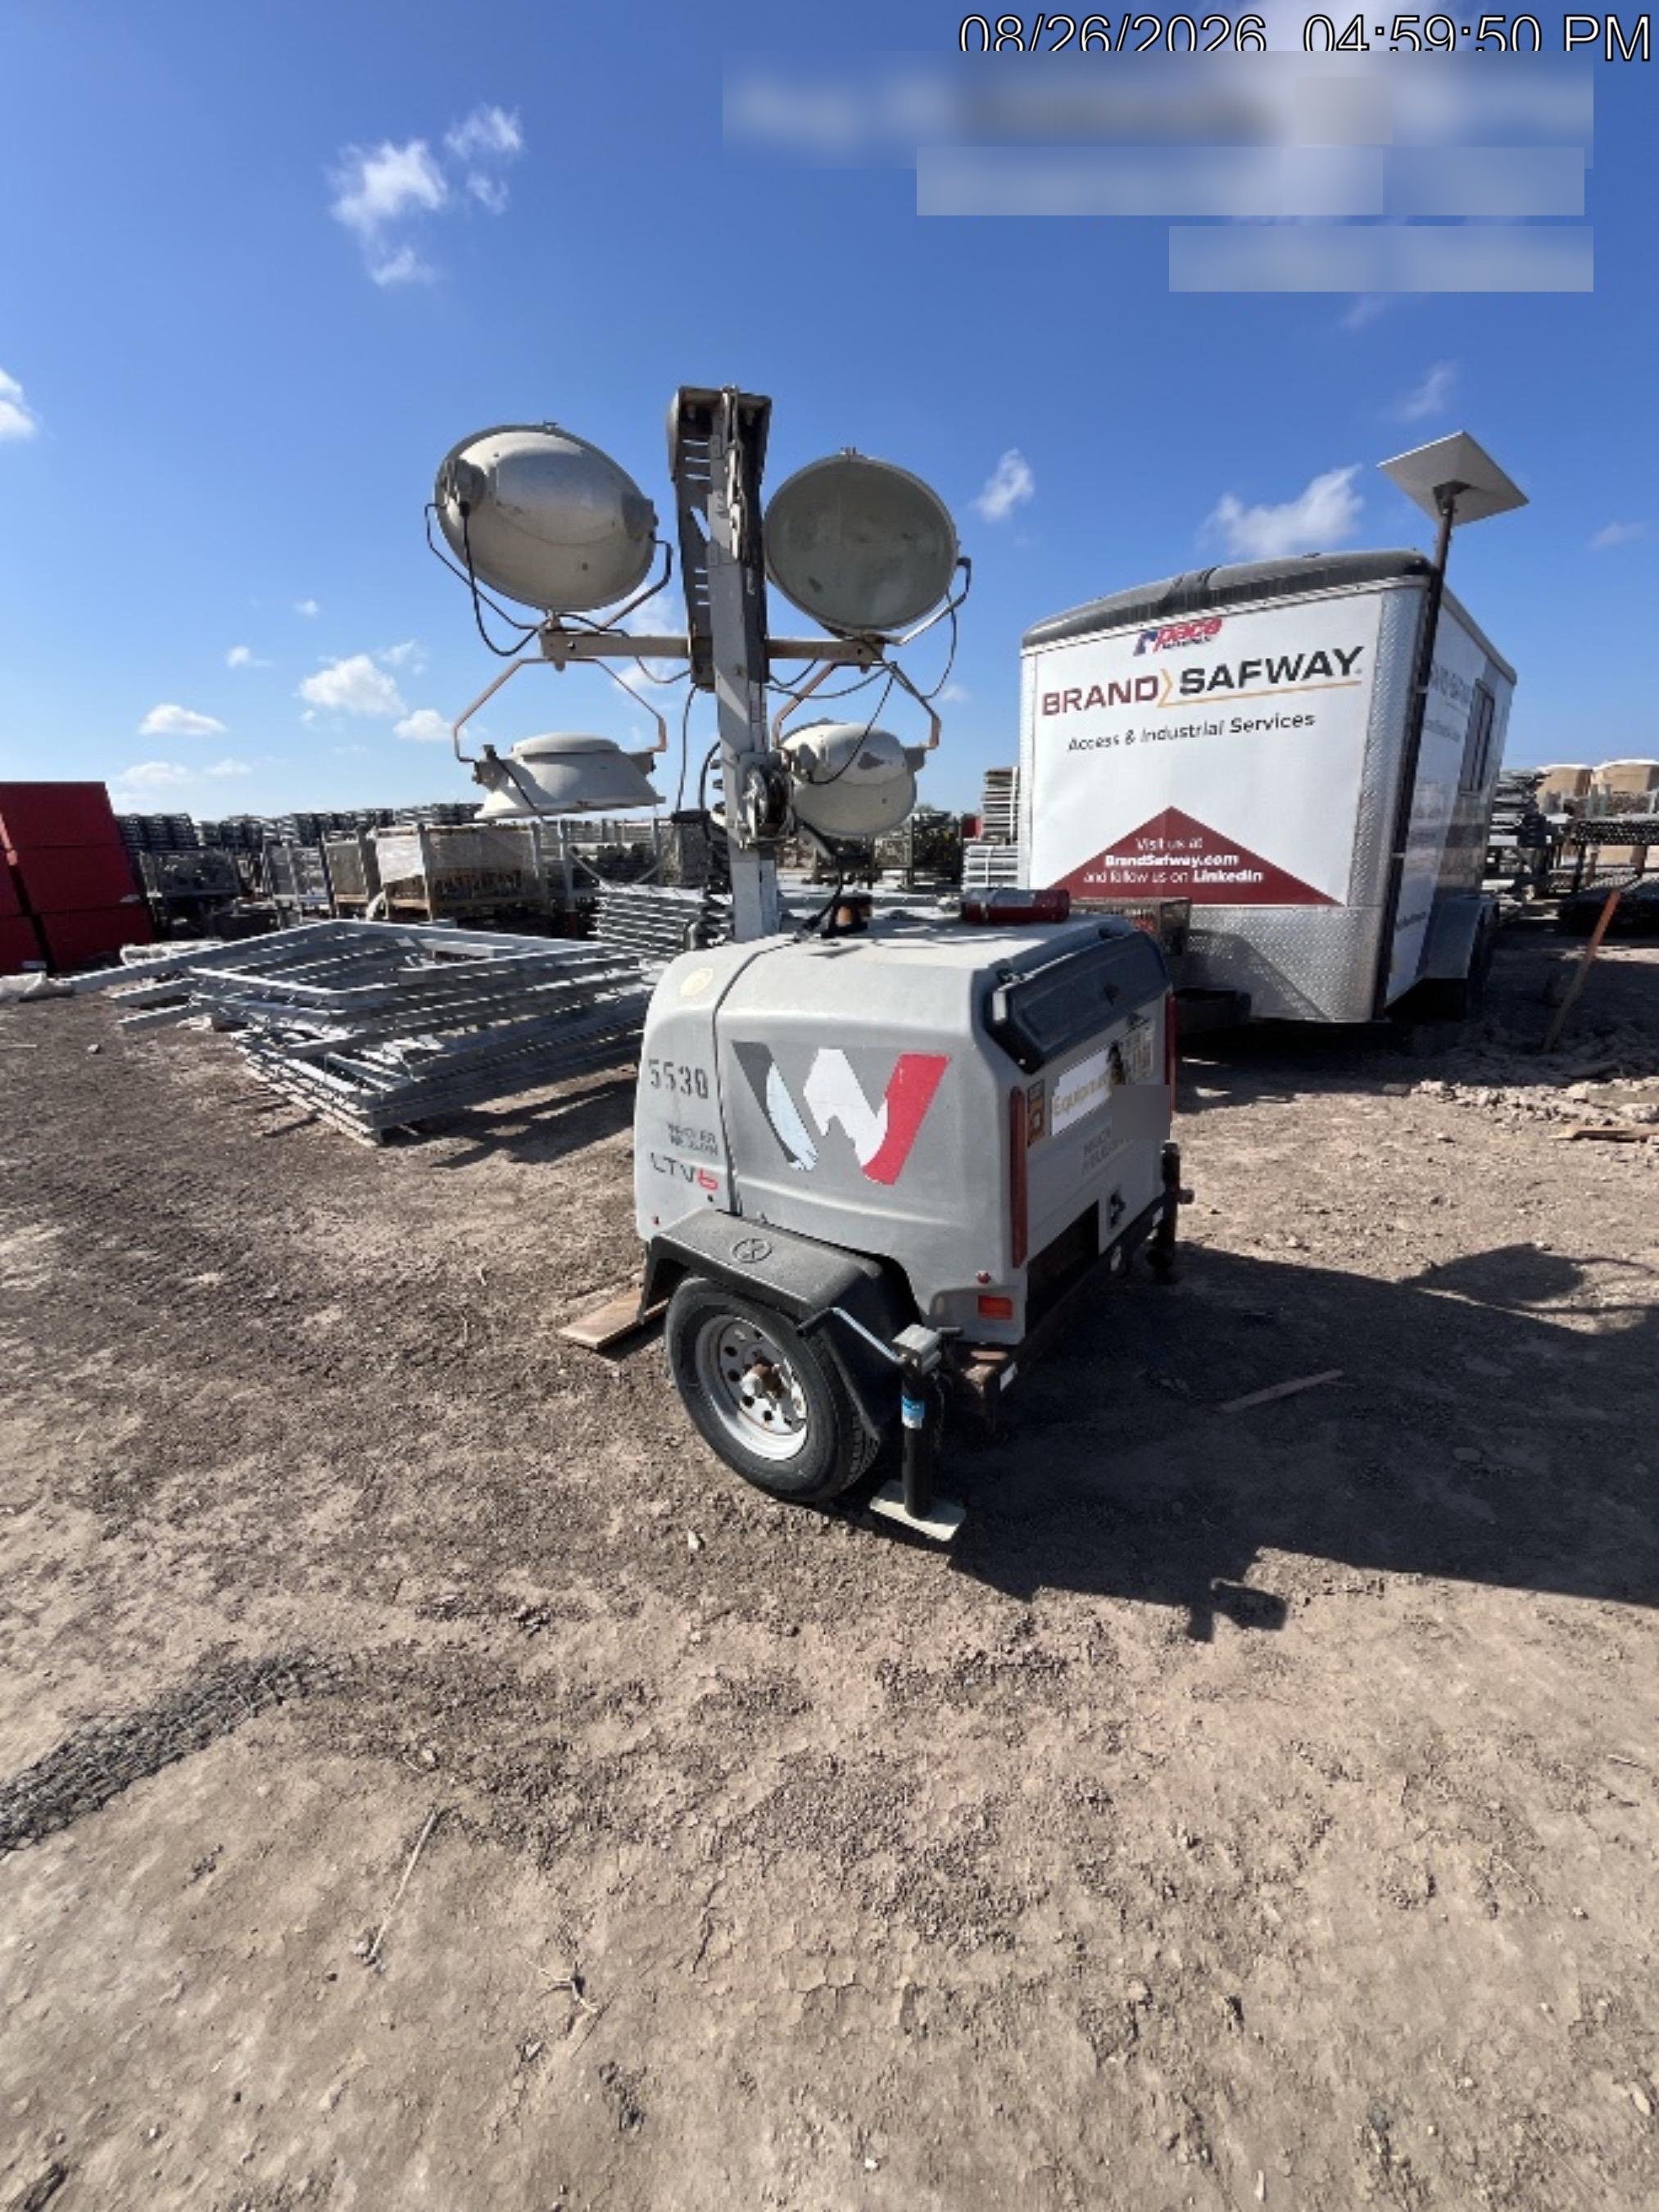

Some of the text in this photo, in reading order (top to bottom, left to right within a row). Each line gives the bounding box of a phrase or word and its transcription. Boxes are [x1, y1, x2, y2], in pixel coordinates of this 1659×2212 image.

[1042, 646, 1364, 716] BRAND SAFWAY
[1068, 712, 1316, 751] Access & Industrial Services
[1135, 837, 1163, 850] Visit
[1105, 853, 1239, 868] BrandSafway.com
[1084, 871, 1106, 883] and
[1110, 871, 1148, 883] follow
[1152, 873, 1167, 883] us
[1172, 873, 1188, 883] on
[649, 1058, 709, 1099] 5530
